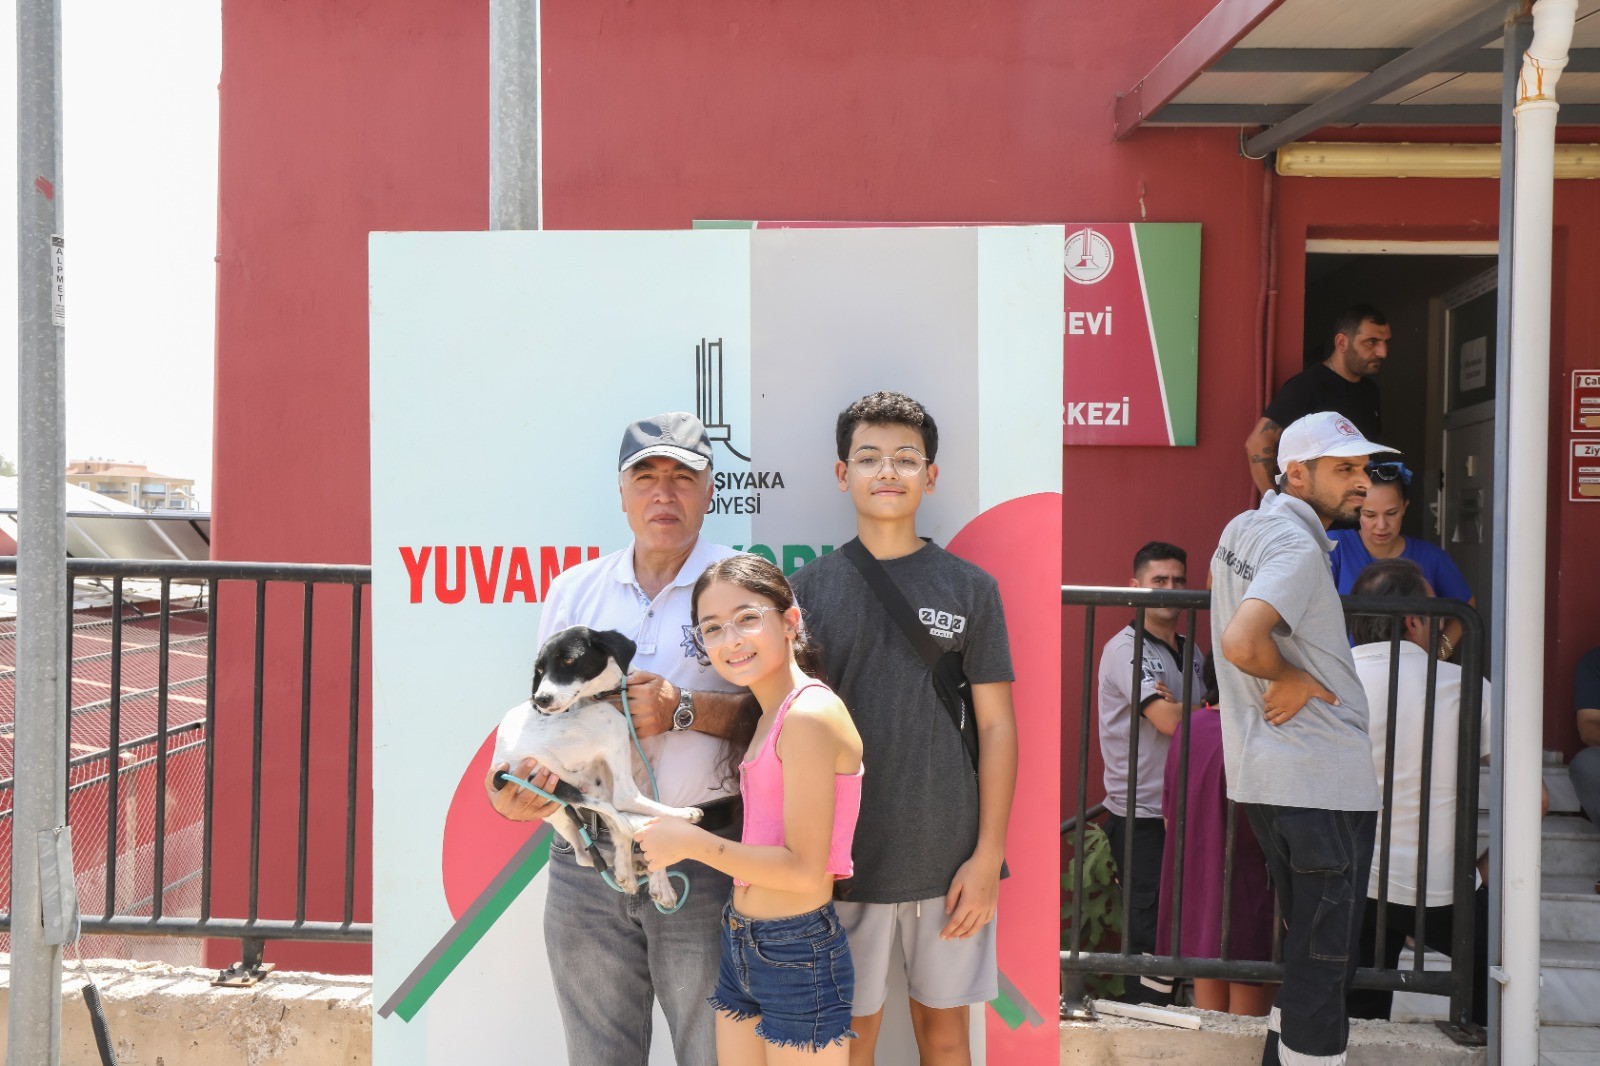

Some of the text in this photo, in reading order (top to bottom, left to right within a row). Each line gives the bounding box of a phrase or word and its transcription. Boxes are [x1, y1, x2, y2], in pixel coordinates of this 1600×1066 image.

[55, 247, 64, 302] ALPMET
[1063, 397, 1129, 426] KEZİ
[398, 546, 600, 604] YUVAM
[920, 609, 964, 631] zaz
